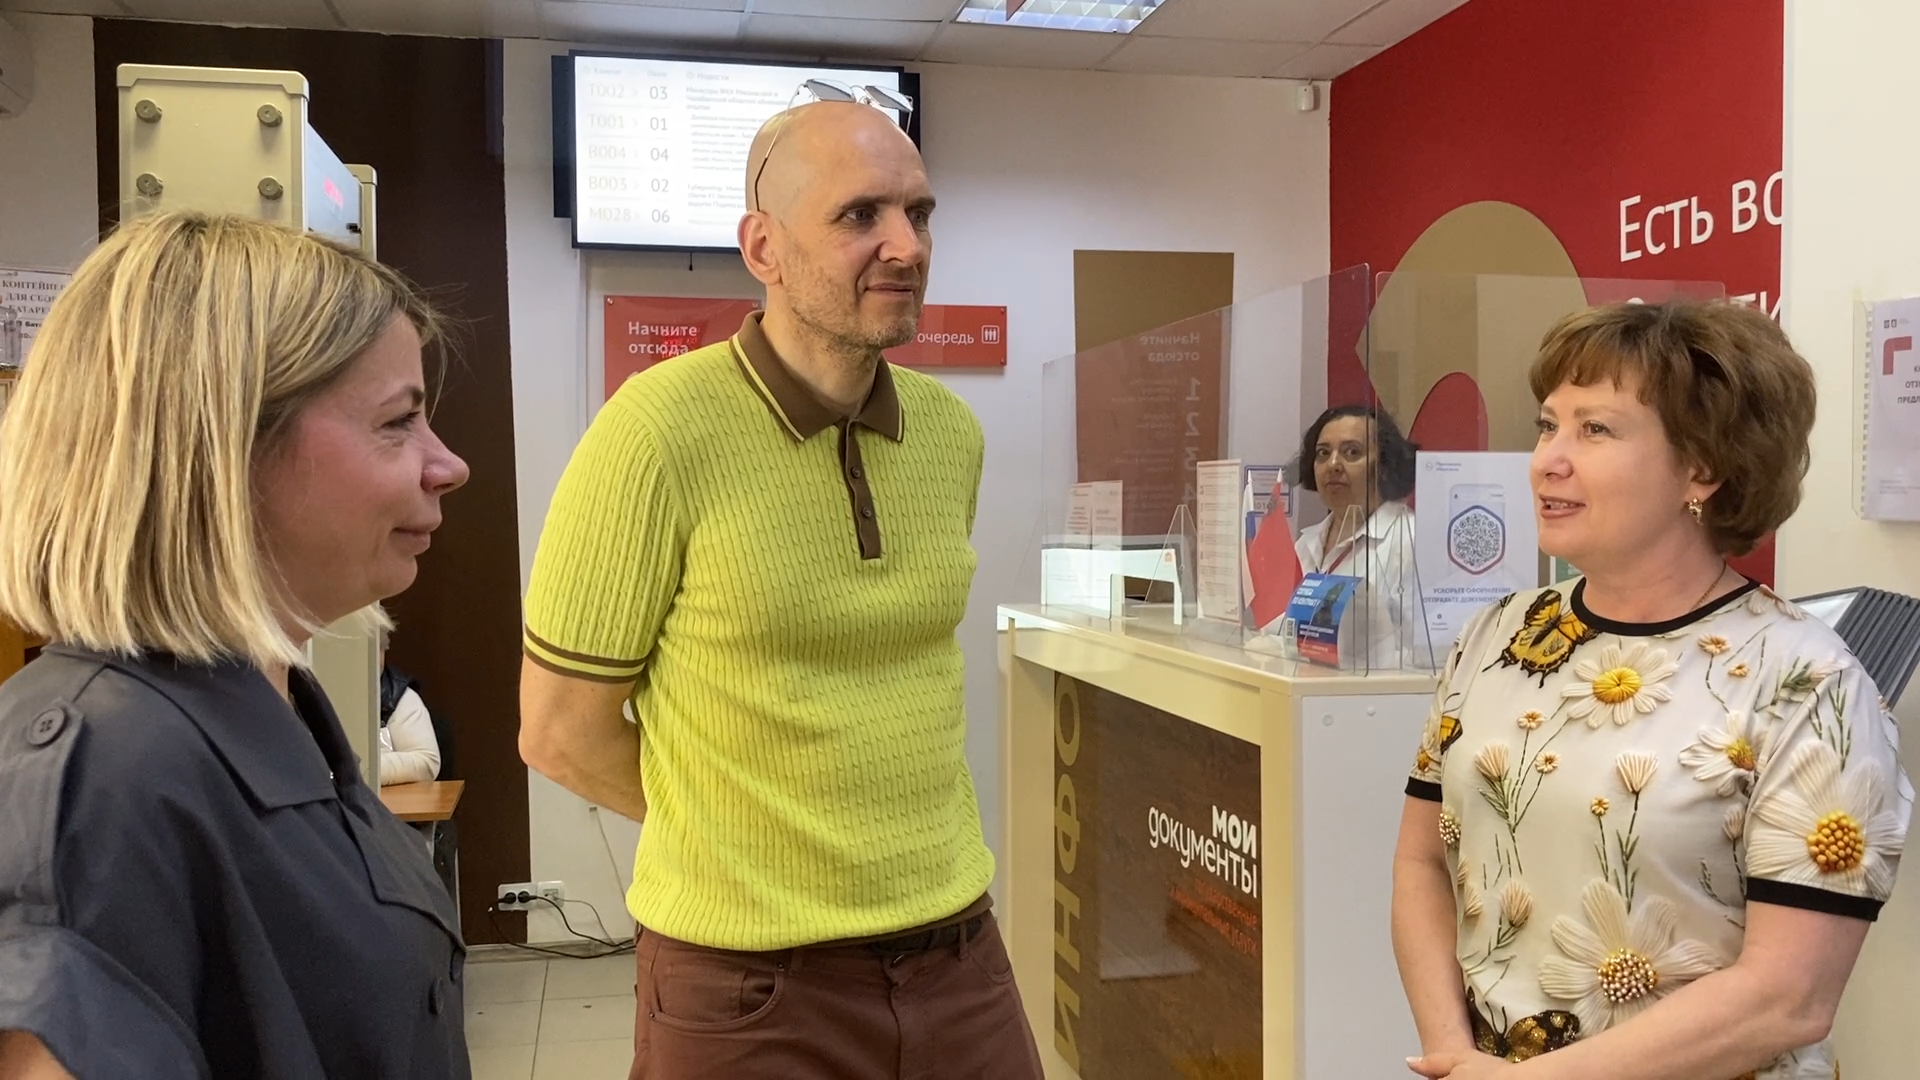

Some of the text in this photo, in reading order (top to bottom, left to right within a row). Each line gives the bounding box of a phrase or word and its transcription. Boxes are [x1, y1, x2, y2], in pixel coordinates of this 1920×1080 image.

[649, 86, 668, 100] 03
[649, 116, 668, 131] 01
[650, 147, 670, 161] 04
[651, 178, 669, 192] 02
[651, 209, 670, 223] 06
[1620, 195, 1714, 262] Есть
[628, 321, 698, 337] Начните
[917, 332, 975, 347] очередь
[628, 343, 689, 356] отсюда
[1212, 804, 1257, 859] мои
[1148, 806, 1257, 898] документы
[1054, 674, 1081, 1076] ИНФО
